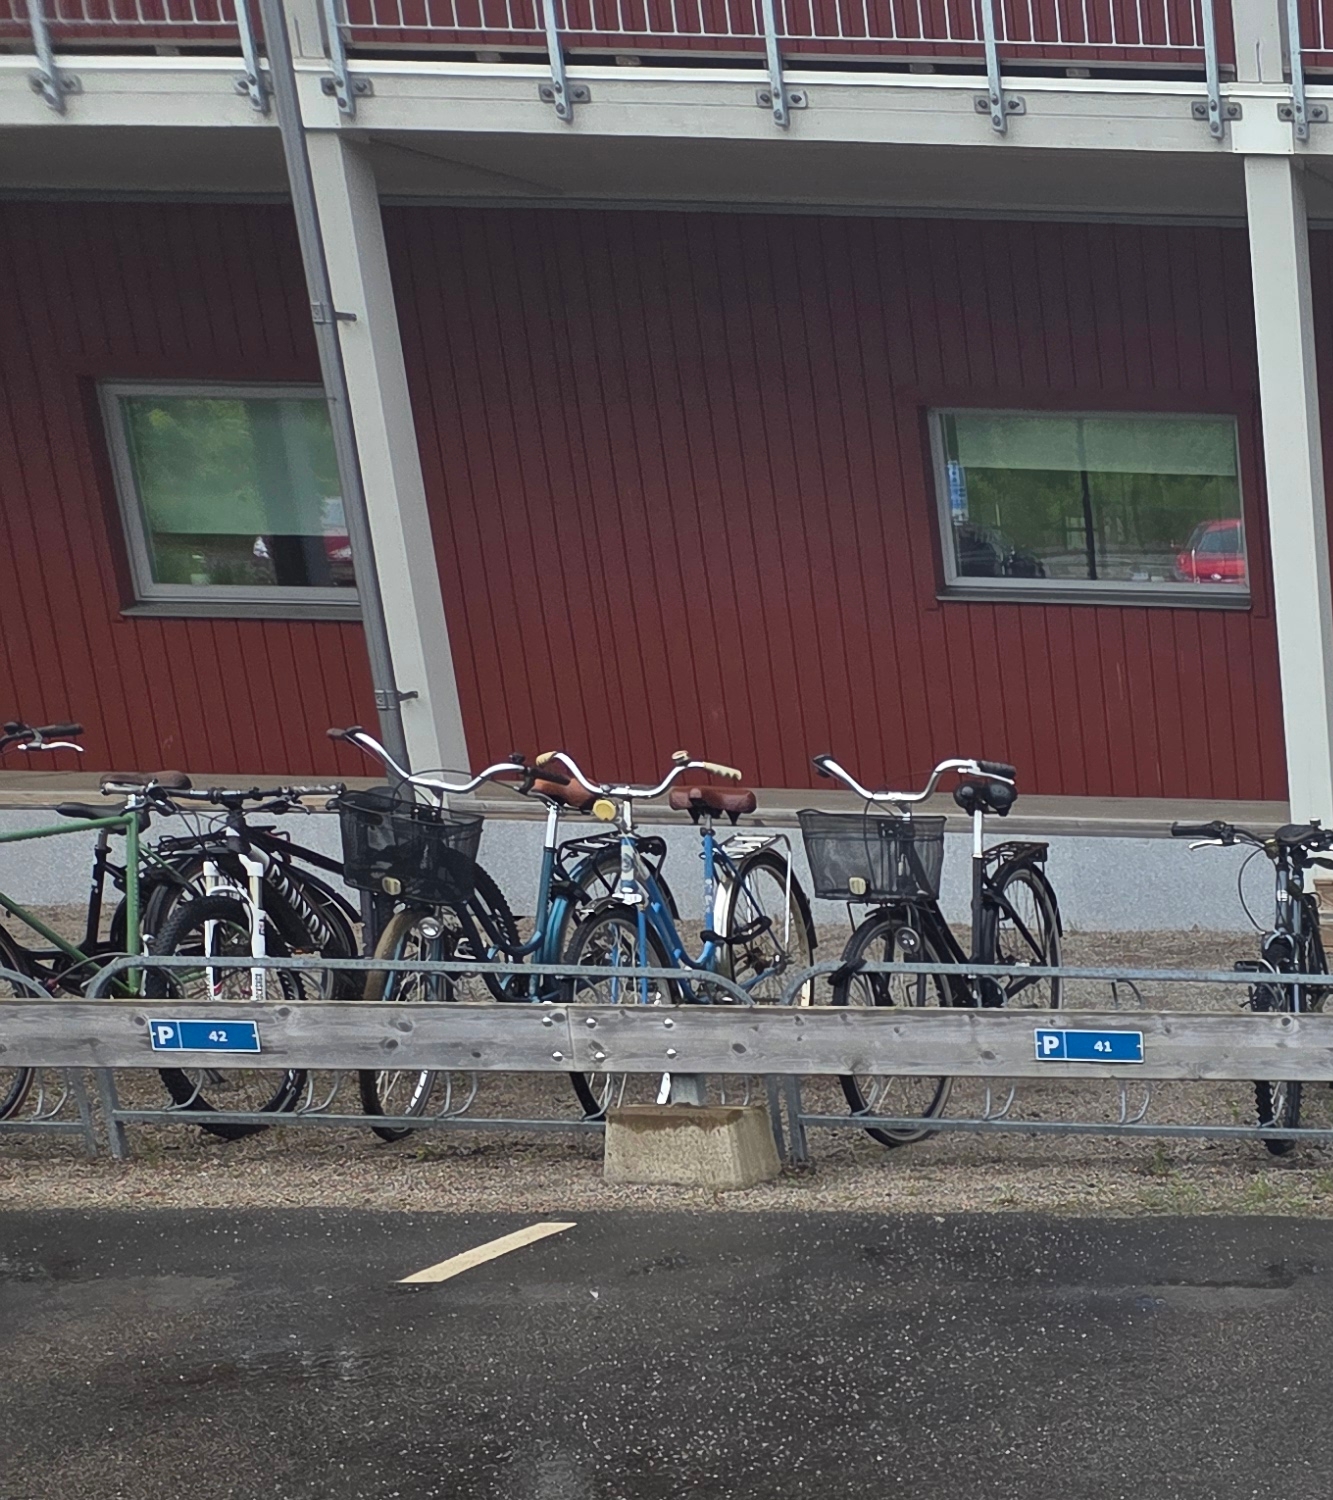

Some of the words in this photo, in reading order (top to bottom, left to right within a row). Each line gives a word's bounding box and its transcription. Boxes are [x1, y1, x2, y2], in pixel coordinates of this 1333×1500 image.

[266, 863, 331, 947] CANYON
[157, 1025, 174, 1045] P
[208, 1030, 228, 1042] 42
[1042, 1035, 1060, 1055] P
[1093, 1040, 1113, 1052] 41
